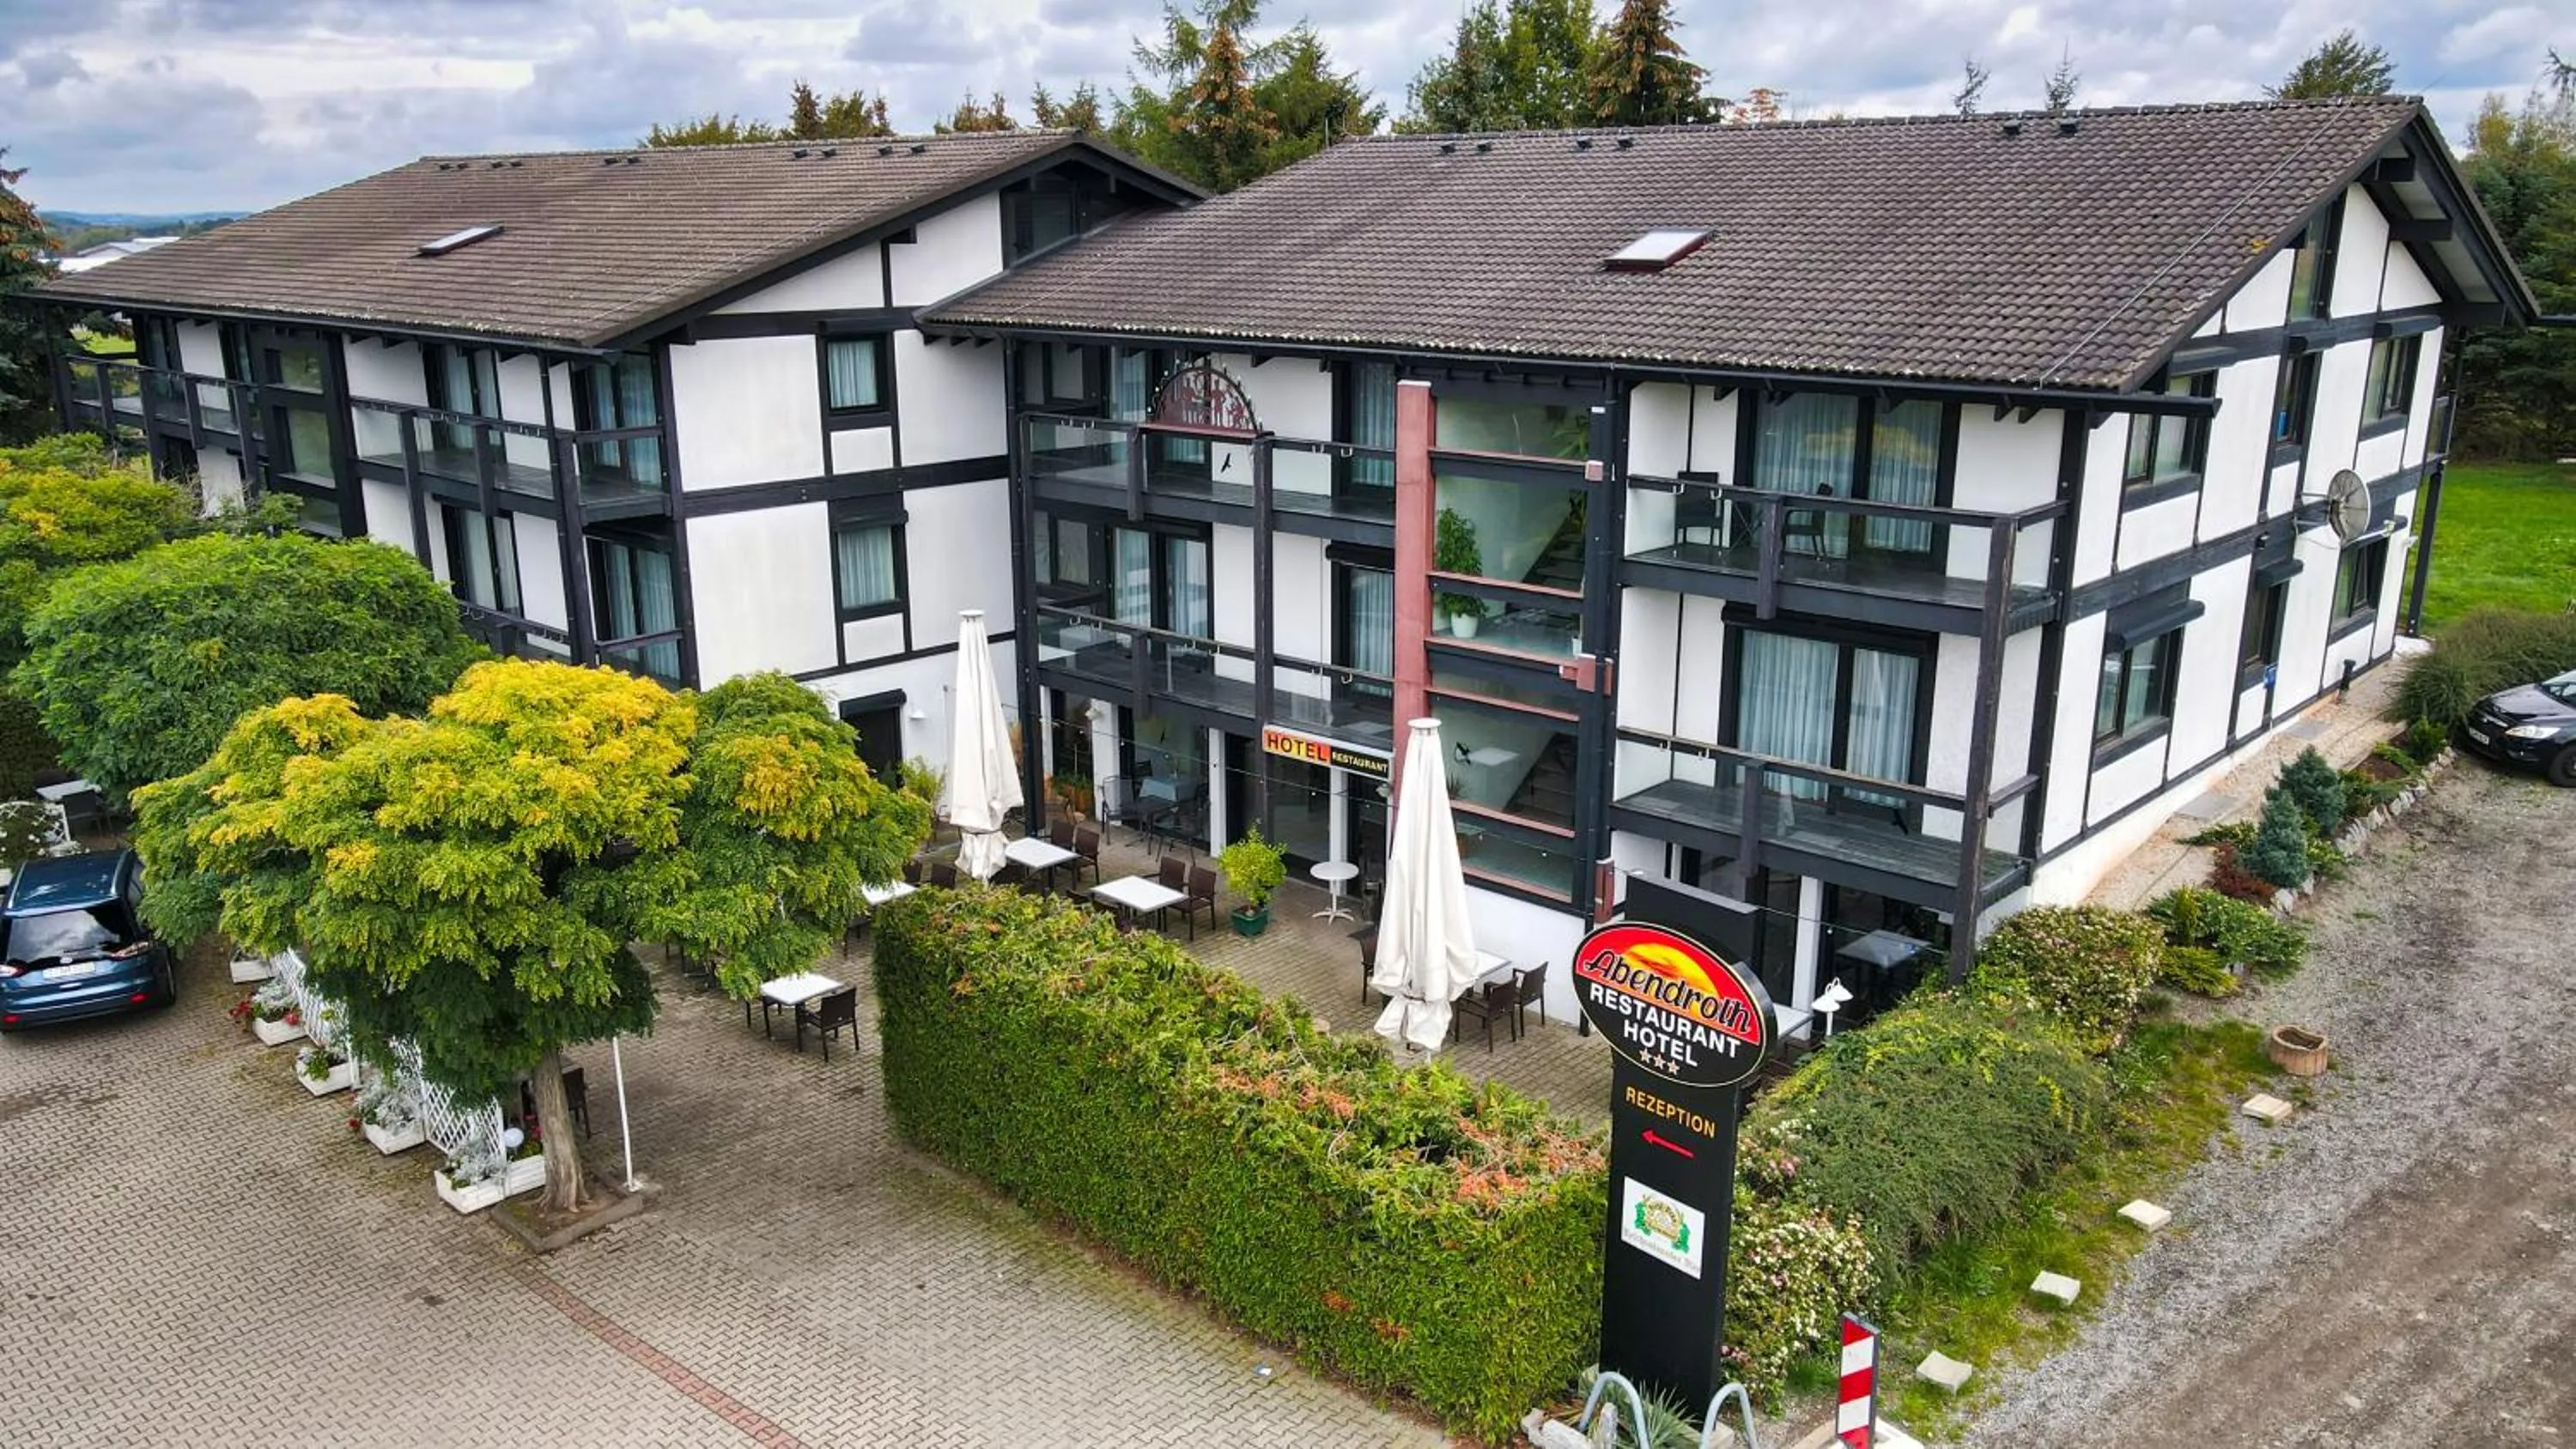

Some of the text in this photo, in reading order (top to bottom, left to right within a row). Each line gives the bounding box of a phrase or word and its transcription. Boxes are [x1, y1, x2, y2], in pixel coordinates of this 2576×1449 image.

[1267, 733, 1388, 773] HOTEL RESTAURANT
[1584, 949, 1752, 1033] Abendroth
[1589, 983, 1741, 1058] RESTAURANT
[1624, 1019, 1698, 1067] HOTEL
[1625, 1086, 1716, 1139] REZEPTION
